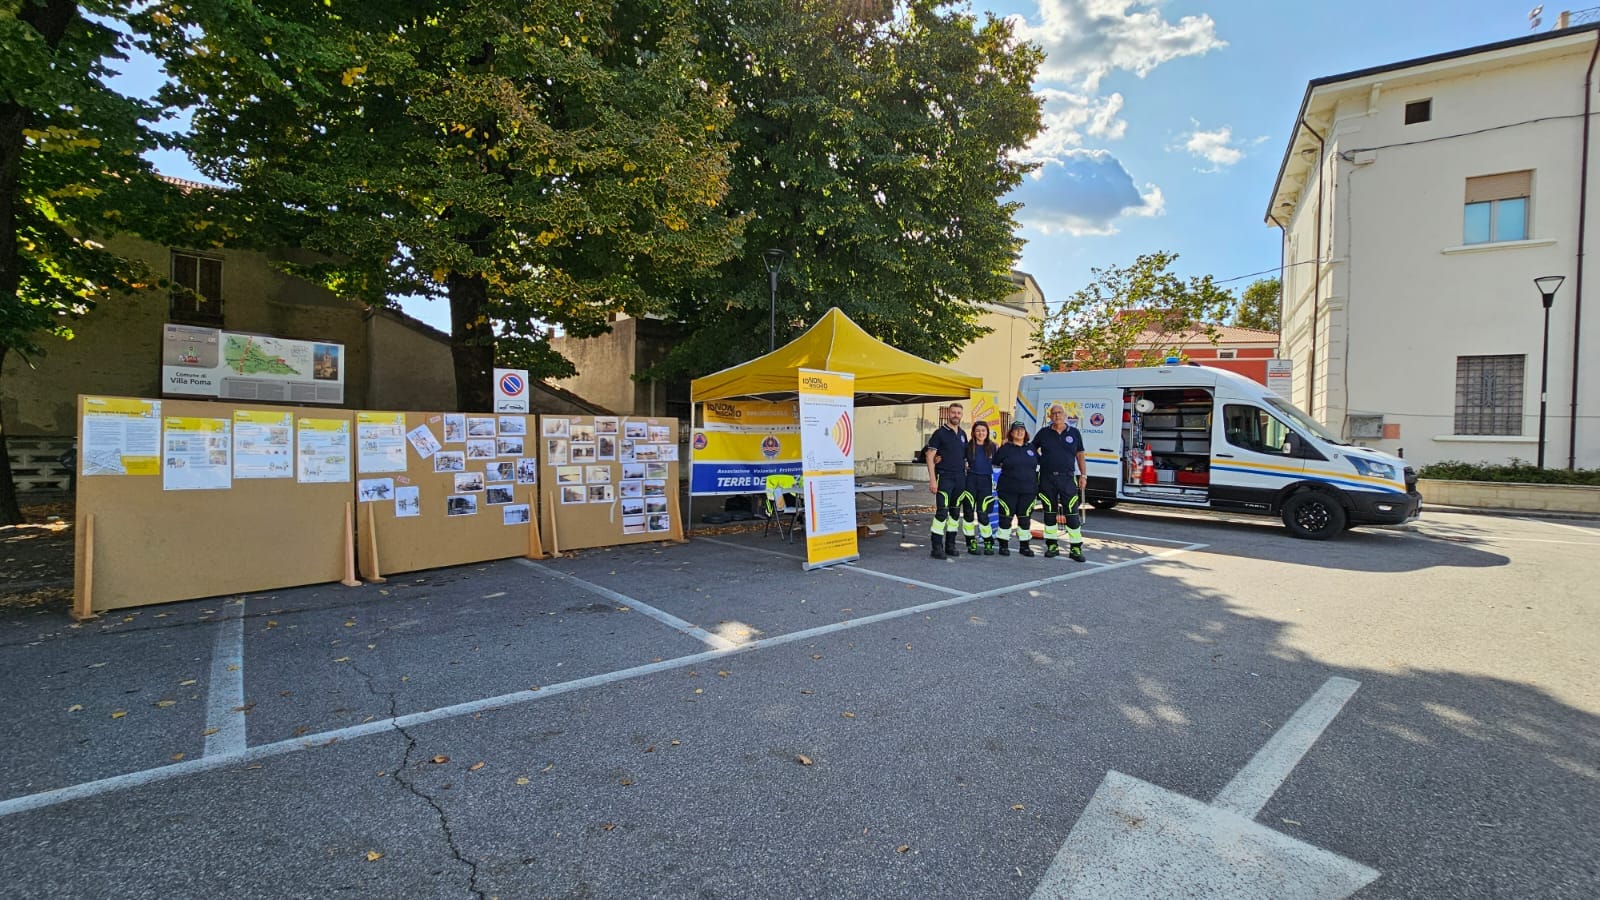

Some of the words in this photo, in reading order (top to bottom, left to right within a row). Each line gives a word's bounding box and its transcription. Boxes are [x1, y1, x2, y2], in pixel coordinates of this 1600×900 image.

[175, 371, 199, 379] Comune
[170, 377, 188, 385] Villa
[190, 378, 212, 386] Poma
[717, 476, 751, 488] TERRE
